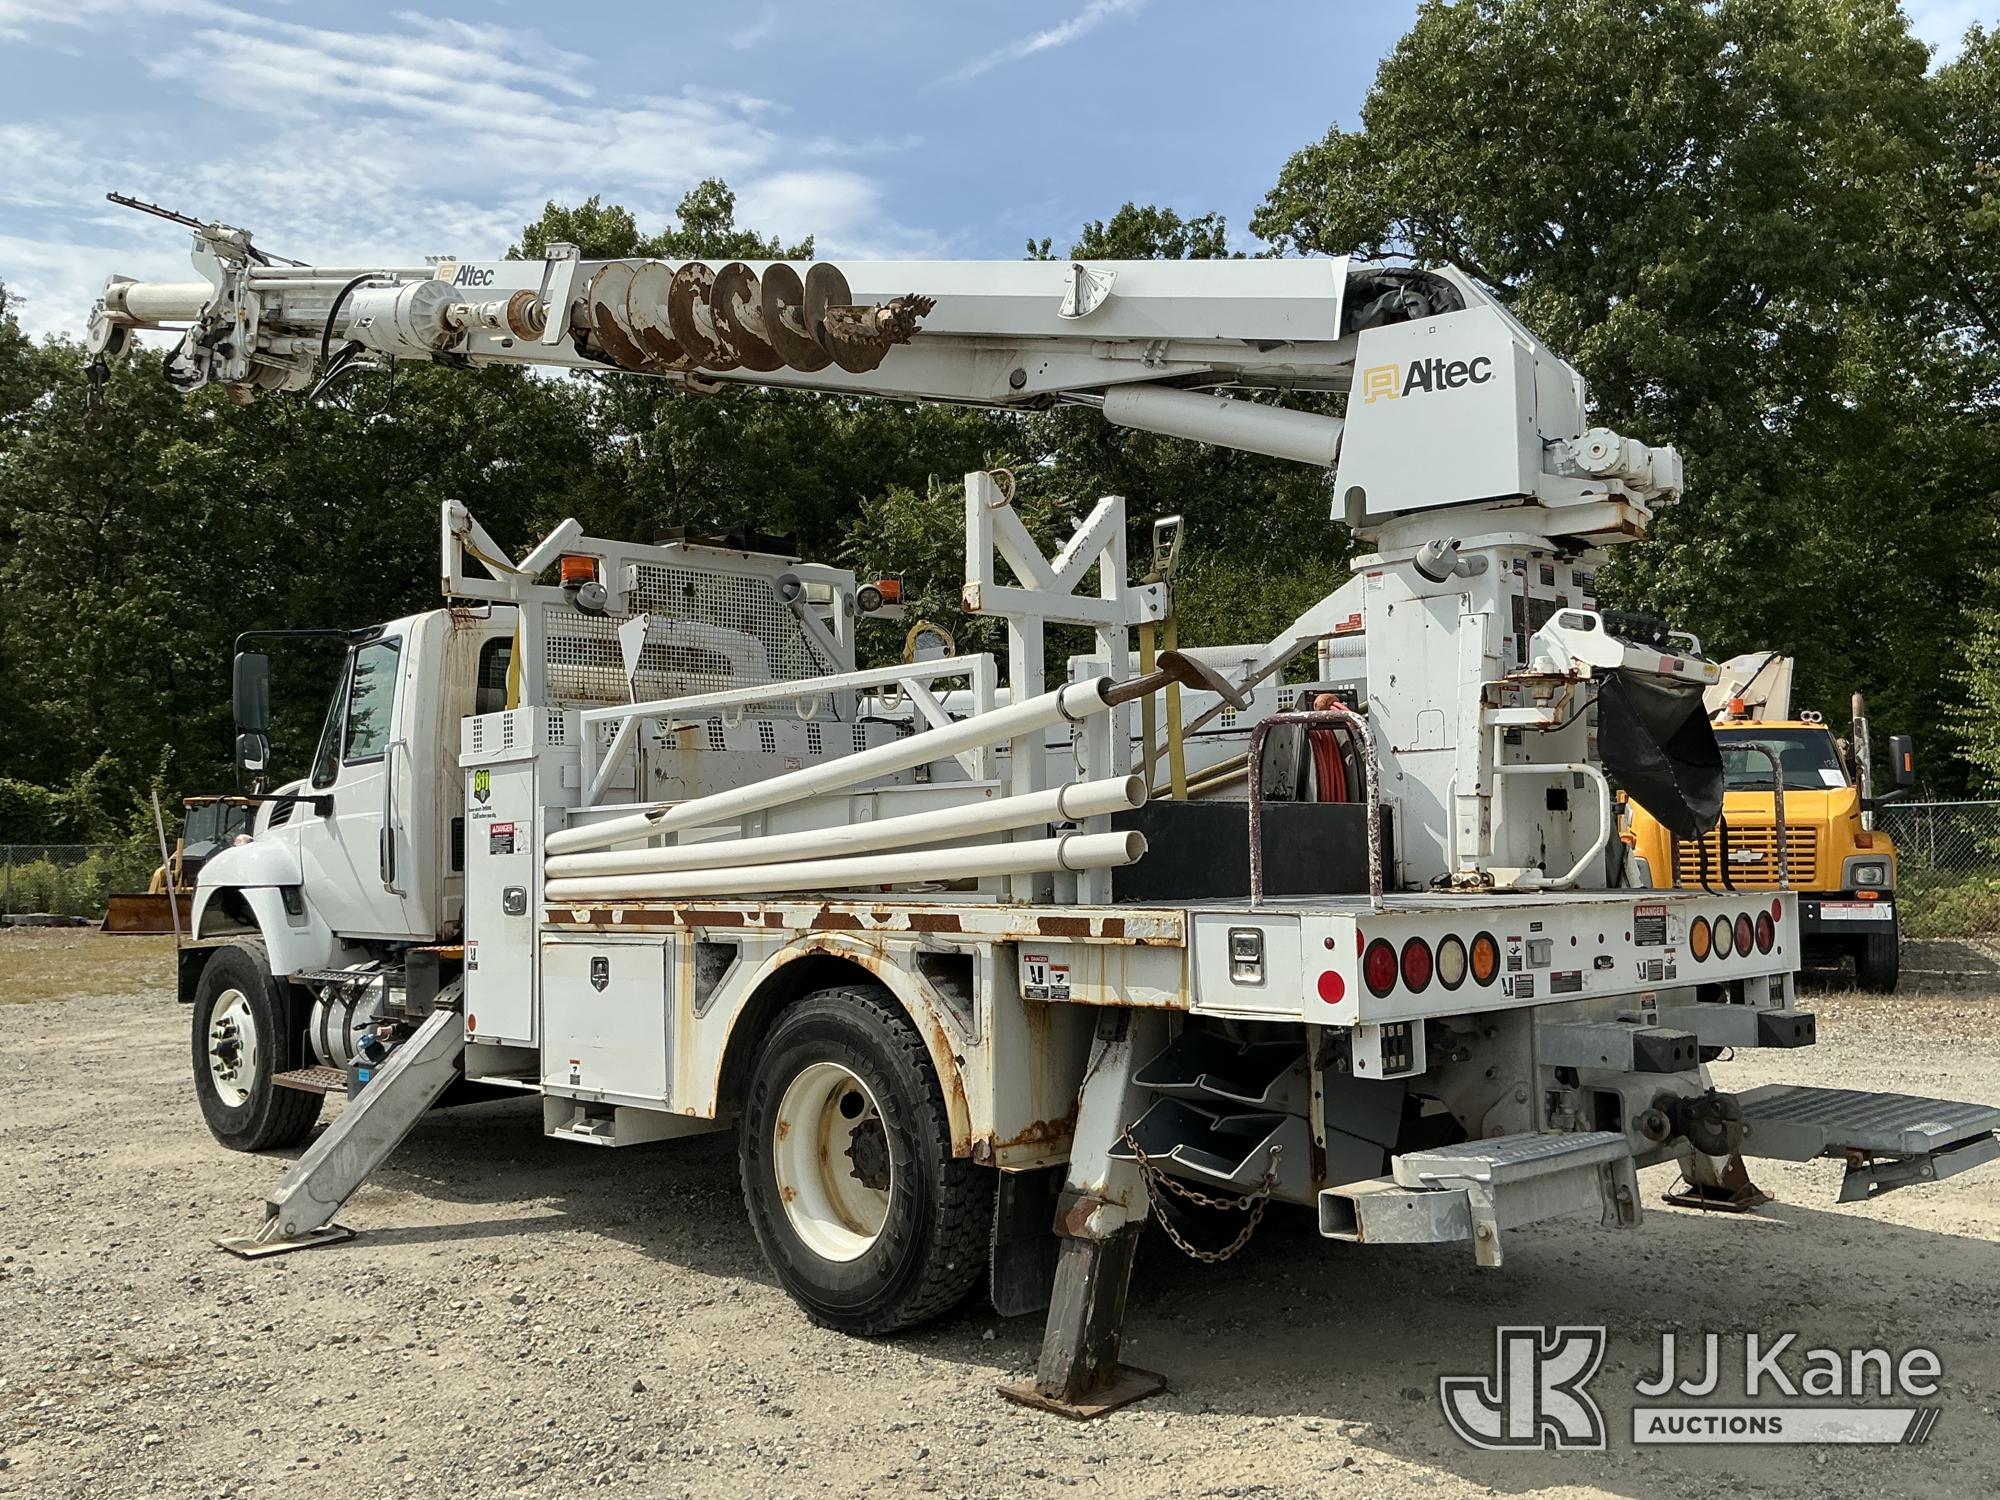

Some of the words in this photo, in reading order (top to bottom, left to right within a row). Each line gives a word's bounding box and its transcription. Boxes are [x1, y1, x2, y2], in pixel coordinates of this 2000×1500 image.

[453, 265, 494, 286] Altec
[1402, 356, 1492, 397] Altec
[475, 770, 489, 792] 811
[494, 824, 513, 832] DANGER
[1641, 906, 1664, 916] DANGER
